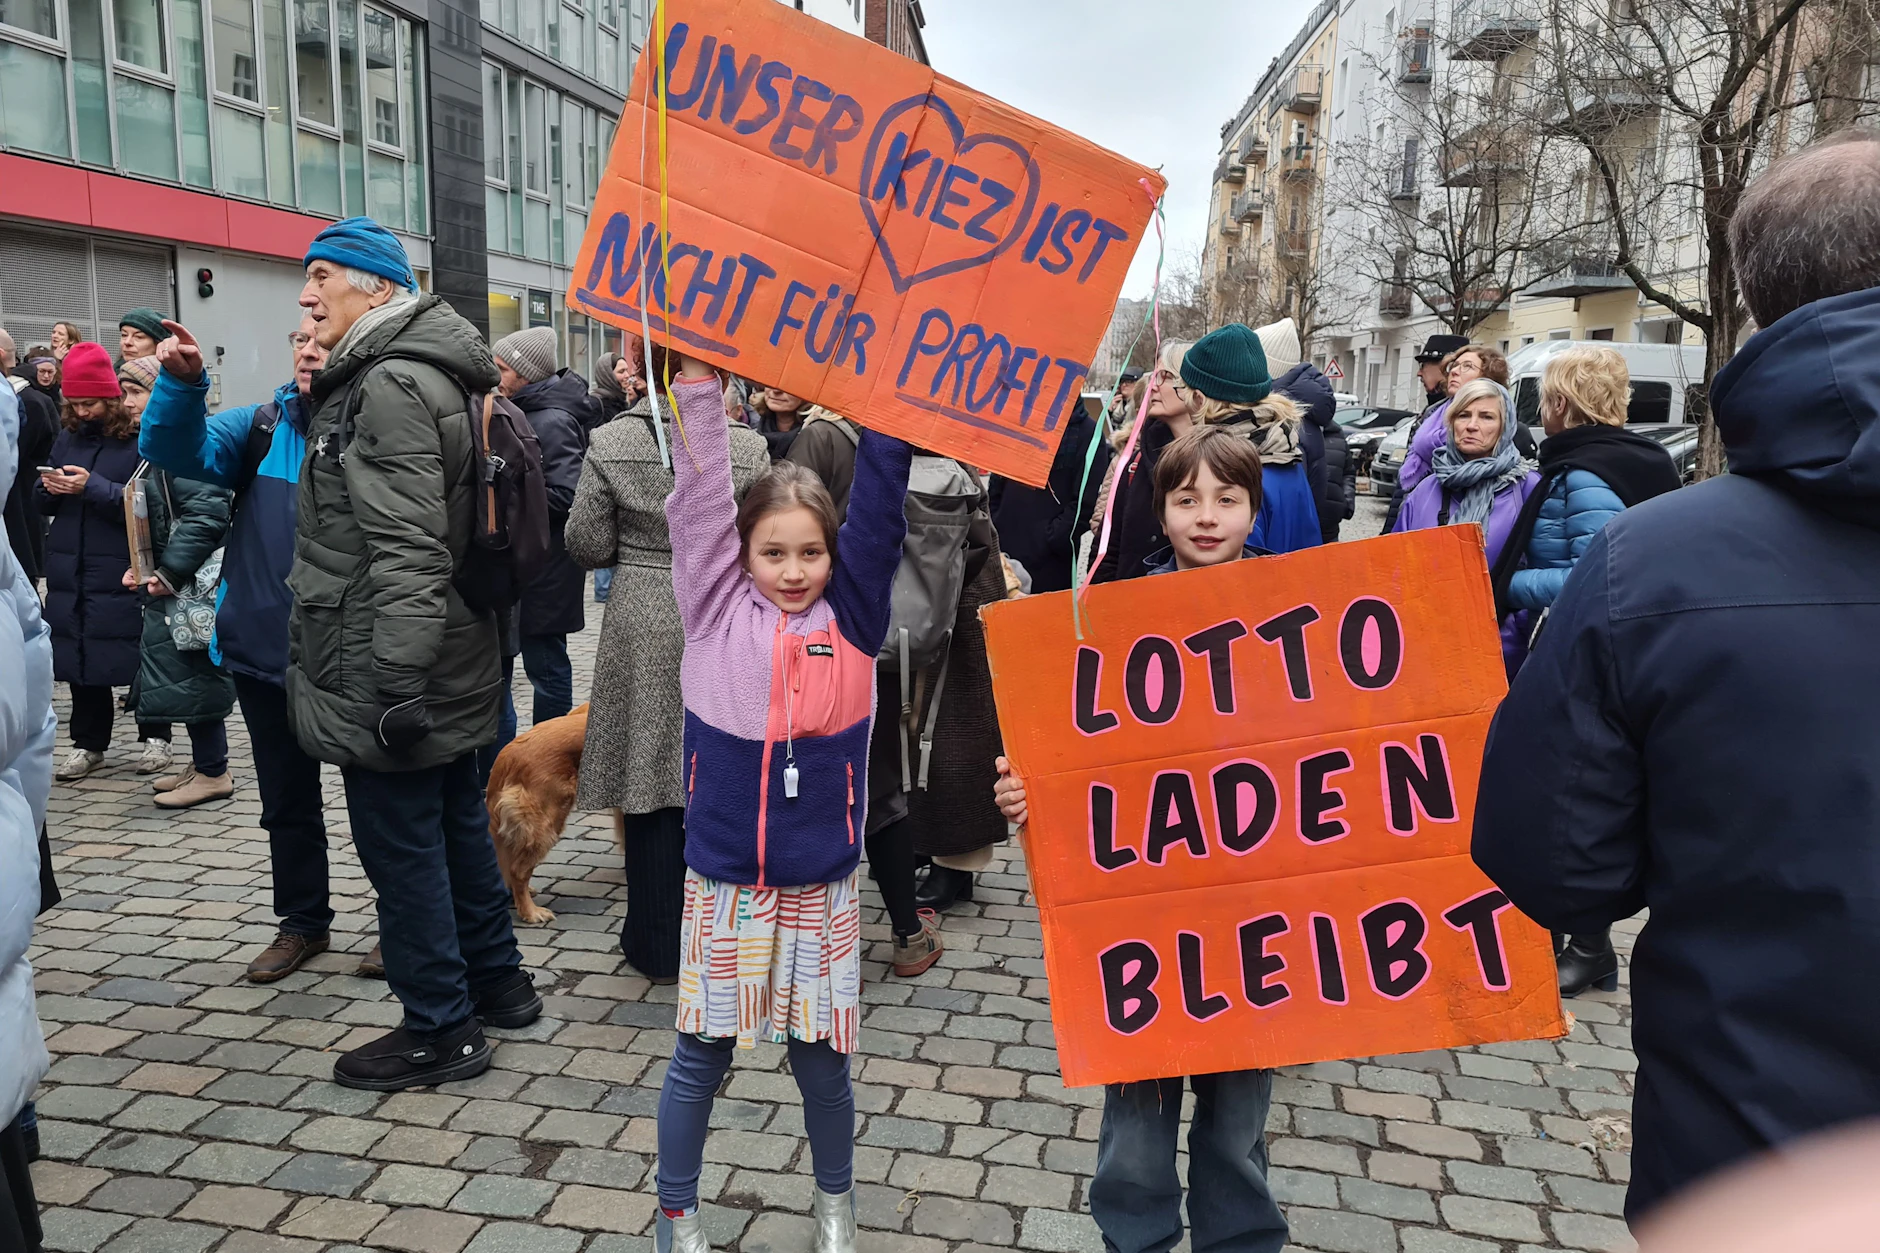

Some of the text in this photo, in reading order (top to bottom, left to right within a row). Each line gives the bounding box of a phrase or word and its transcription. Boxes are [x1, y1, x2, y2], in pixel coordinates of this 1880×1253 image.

[653, 22, 1129, 284] UNSER KIEZ IST
[532, 301, 546, 315] THE
[586, 211, 1088, 431] NICHT FÜR PROFIT
[1072, 595, 1404, 736] LOTTO
[1089, 733, 1460, 873] LADEN
[1098, 886, 1512, 1036] BLEIBT
